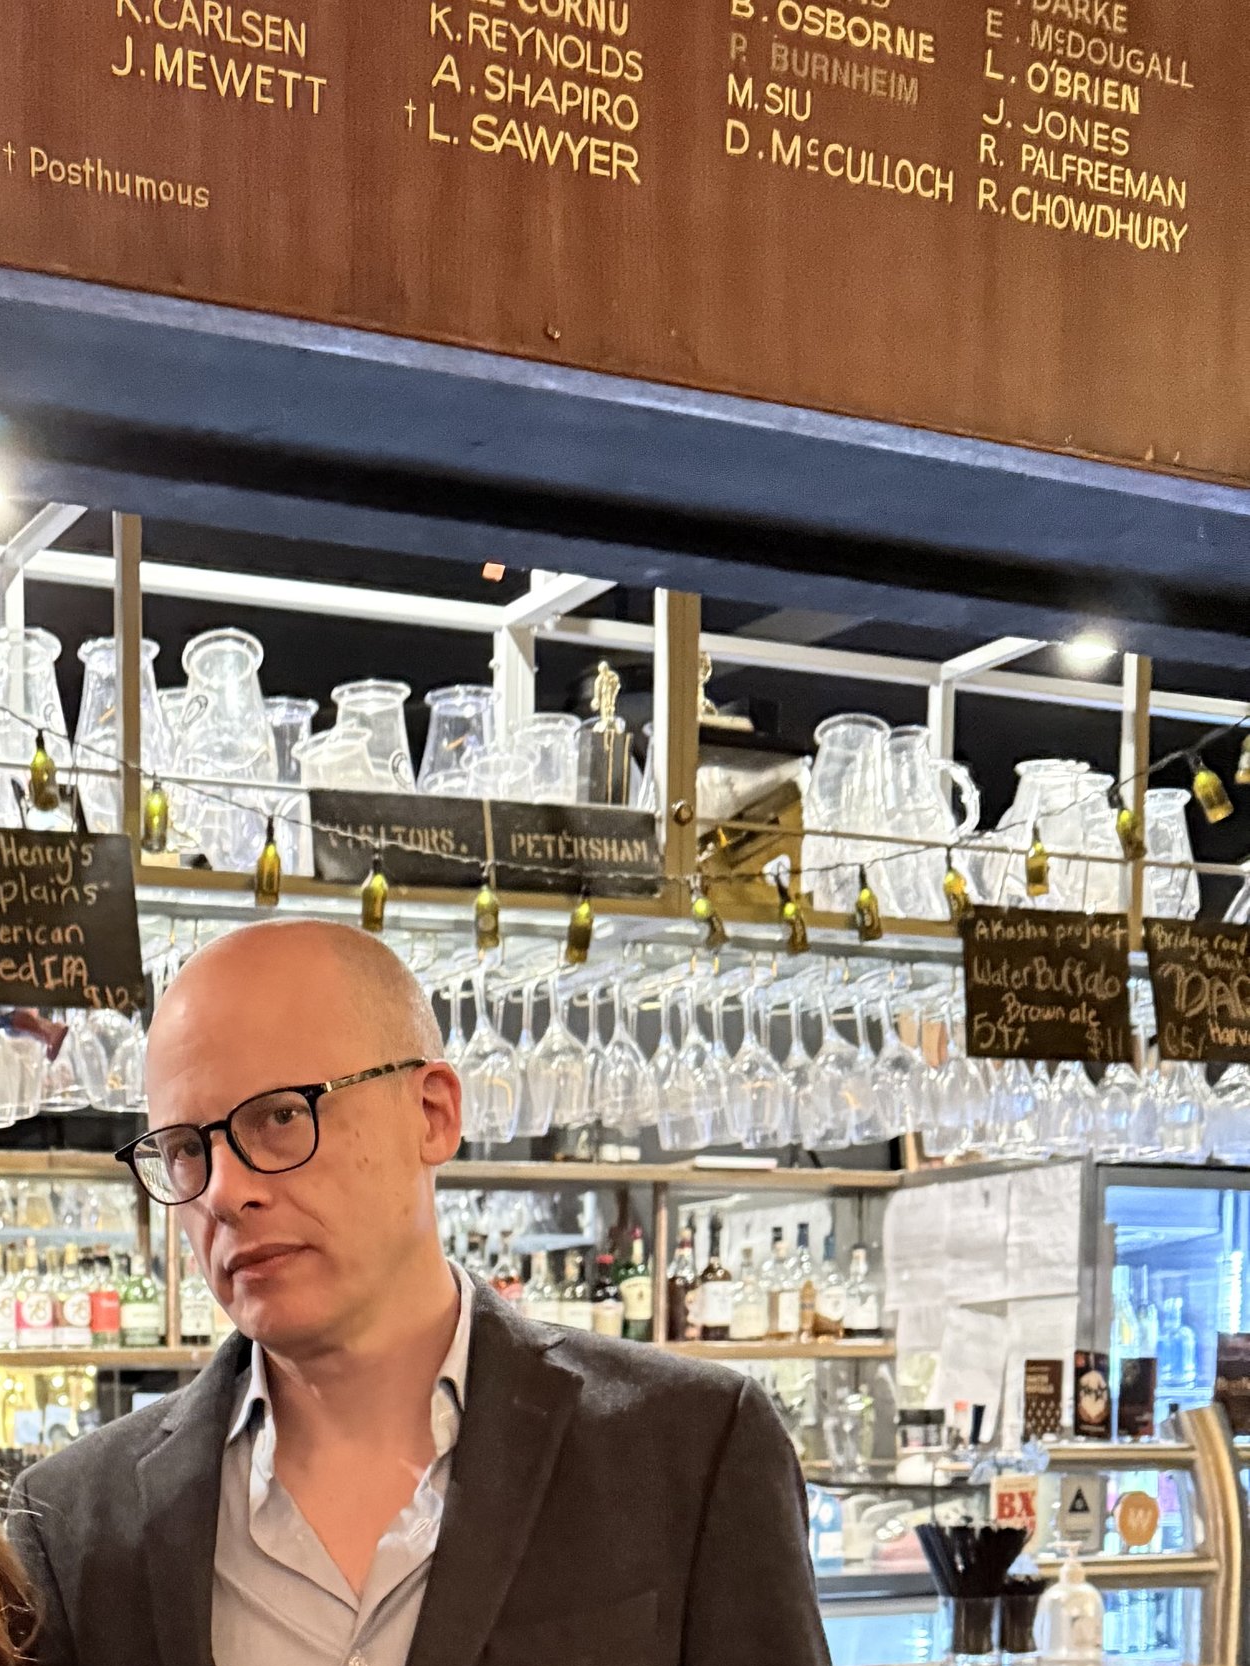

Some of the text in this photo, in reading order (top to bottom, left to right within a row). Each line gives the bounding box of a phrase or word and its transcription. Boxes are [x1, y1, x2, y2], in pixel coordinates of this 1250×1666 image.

[777, 0, 936, 64] OSBORNE
[986, 8, 1021, 43] E.
[484, 64, 640, 131] SHAPIRO
[770, 41, 919, 107] BURNHEIM
[984, 49, 1141, 114] L. O'BRIEN
[428, 103, 641, 185] L. SAWYER
[982, 98, 1131, 156] J. JONES
[29, 146, 210, 208] Posthumous
[979, 133, 1187, 210] R. PALFREEMAN
[996, 1490, 1037, 1520] BX
